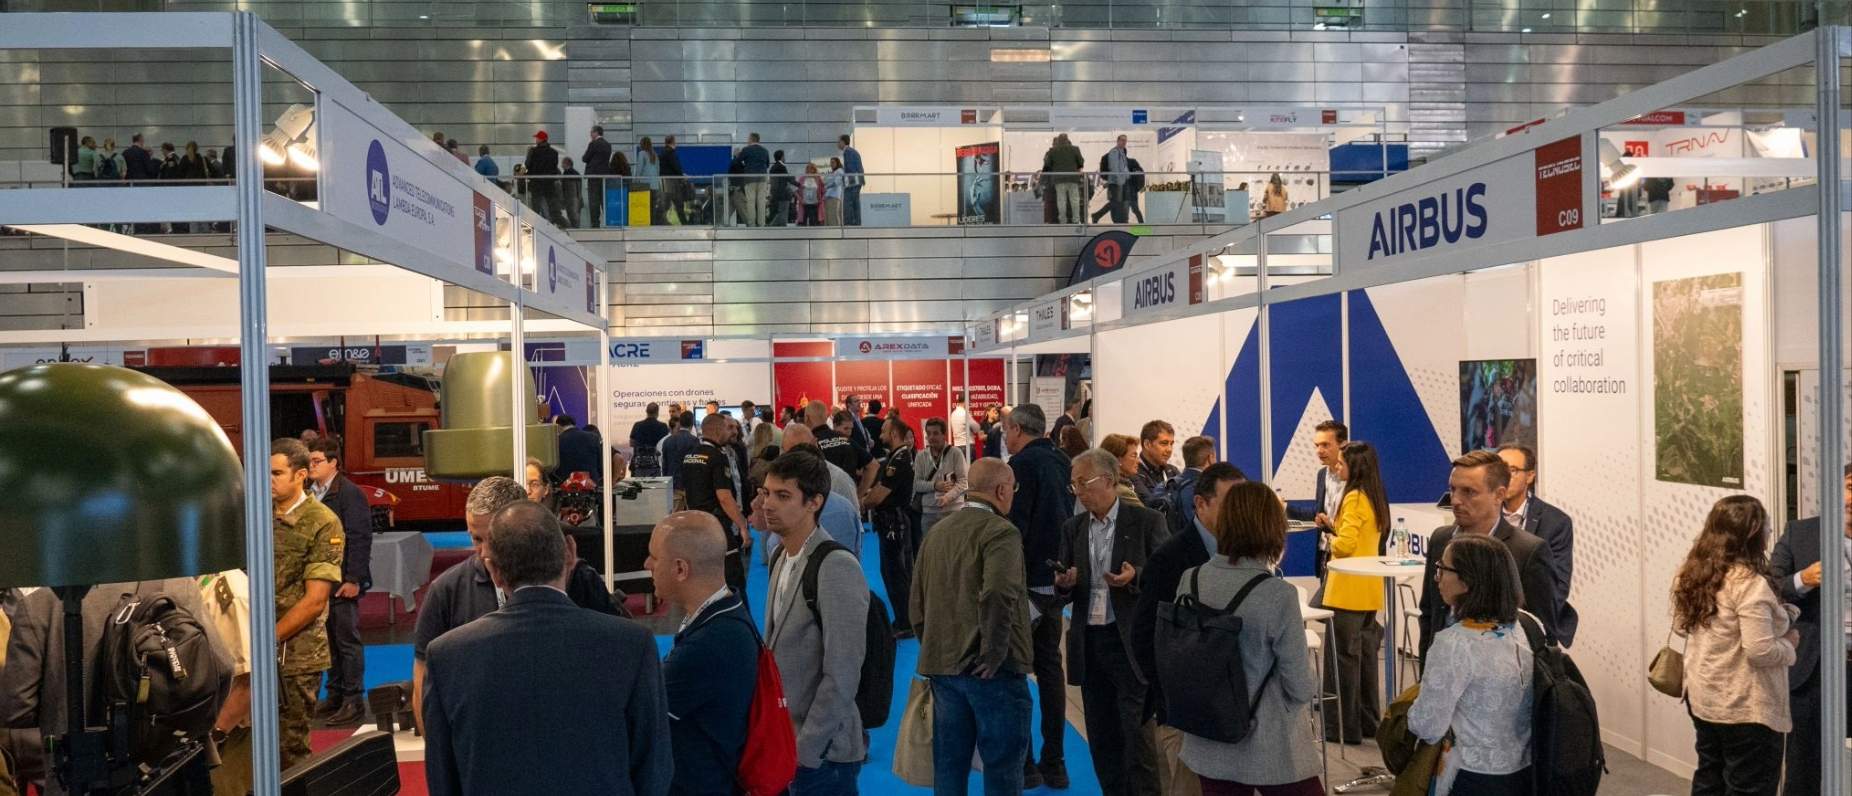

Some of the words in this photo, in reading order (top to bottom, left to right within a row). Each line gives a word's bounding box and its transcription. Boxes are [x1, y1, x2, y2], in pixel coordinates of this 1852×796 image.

[1367, 182, 1488, 260] AIRBUS
[1558, 207, 1579, 228] C09
[1134, 271, 1175, 310] AIRBUS
[1553, 297, 1606, 316] Delivering
[1553, 324, 1569, 341] the
[1572, 322, 1605, 340] future
[1553, 349, 1565, 367] of
[1567, 346, 1604, 367] critical
[613, 390, 667, 399] Operaciones
[668, 389, 686, 397] con
[687, 388, 714, 397] drones
[1553, 376, 1626, 394] collaboration
[385, 468, 428, 484] UME
